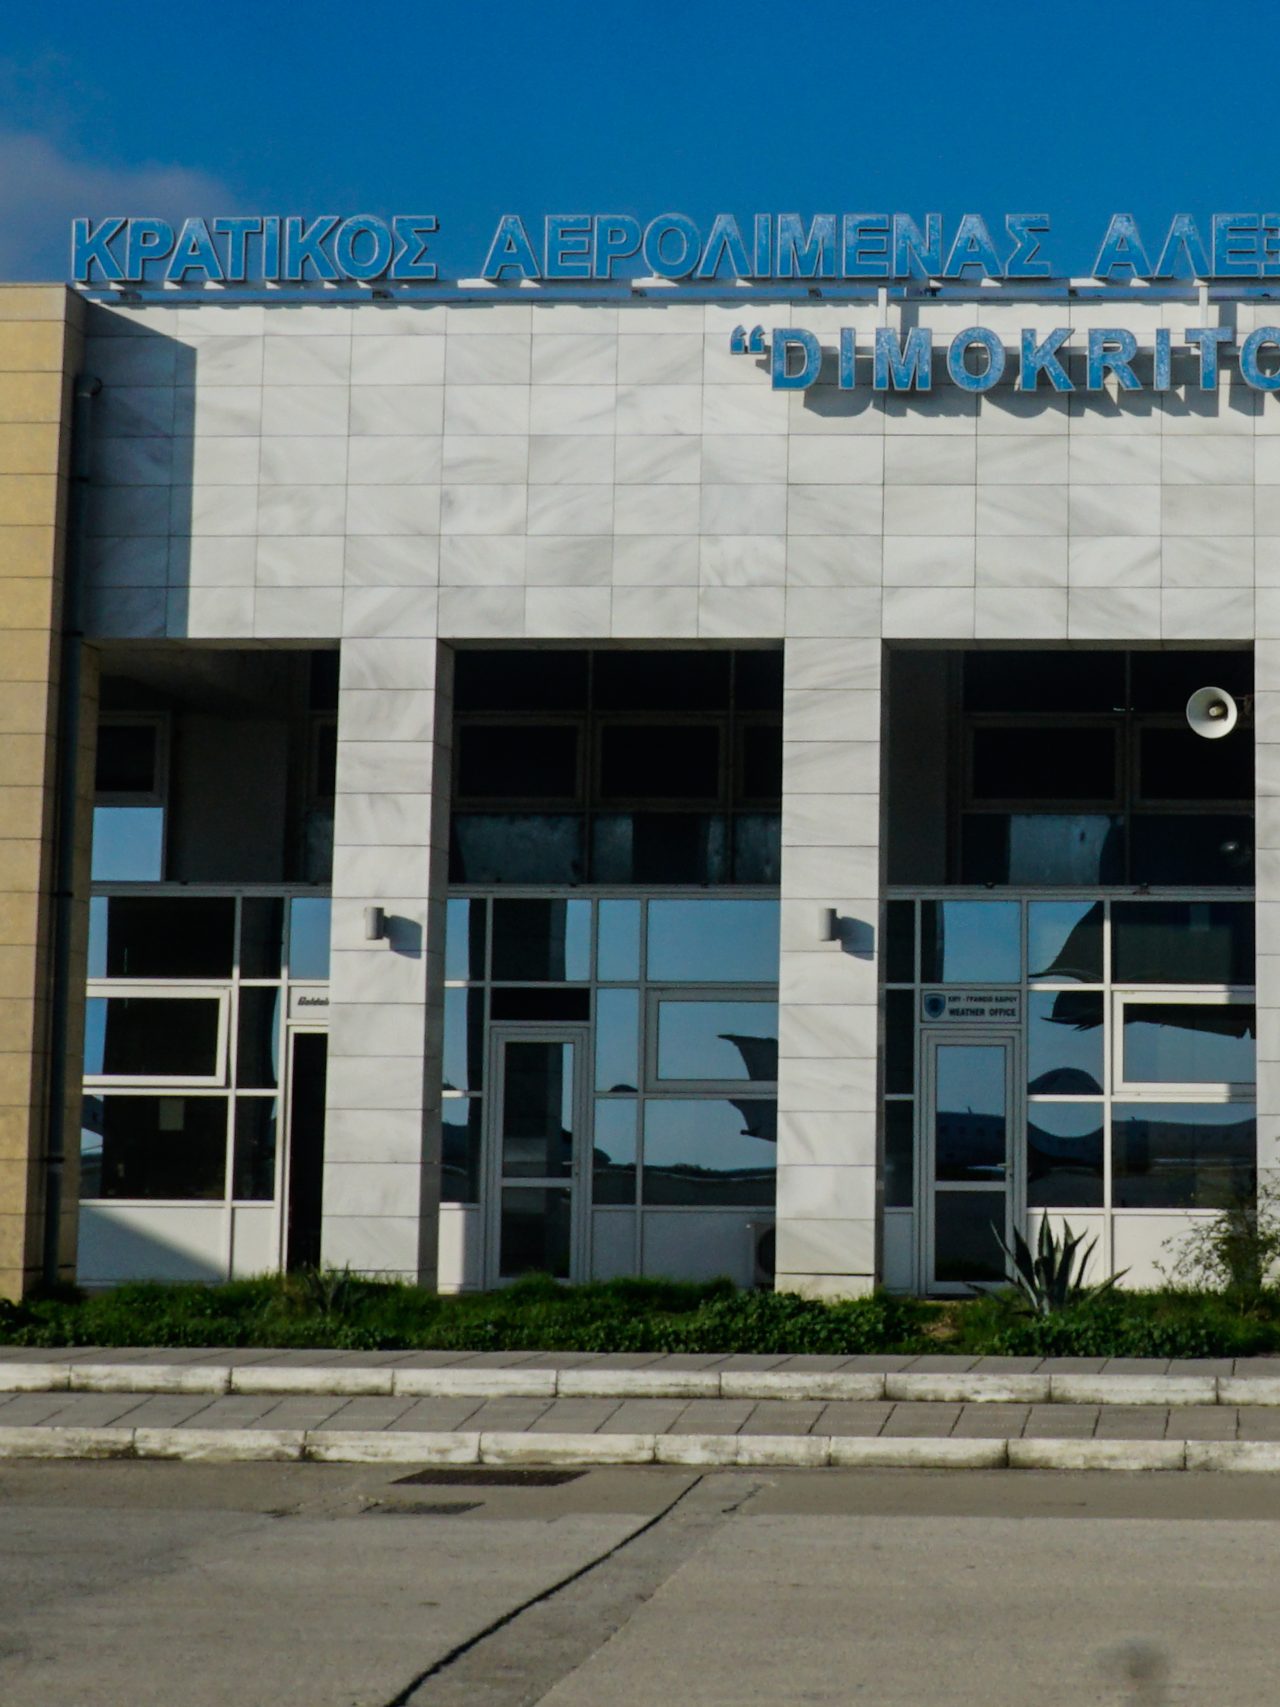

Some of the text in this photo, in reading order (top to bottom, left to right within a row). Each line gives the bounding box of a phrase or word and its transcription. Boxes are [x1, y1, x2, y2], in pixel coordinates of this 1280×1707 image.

[72, 215, 440, 282] ΚΡΑΤΙΚΟΣ
[482, 213, 1051, 281] ΑΕΡΟΛΙΜΕΝΑΣ
[948, 1007, 1016, 1017] WEATHER OFFICE
